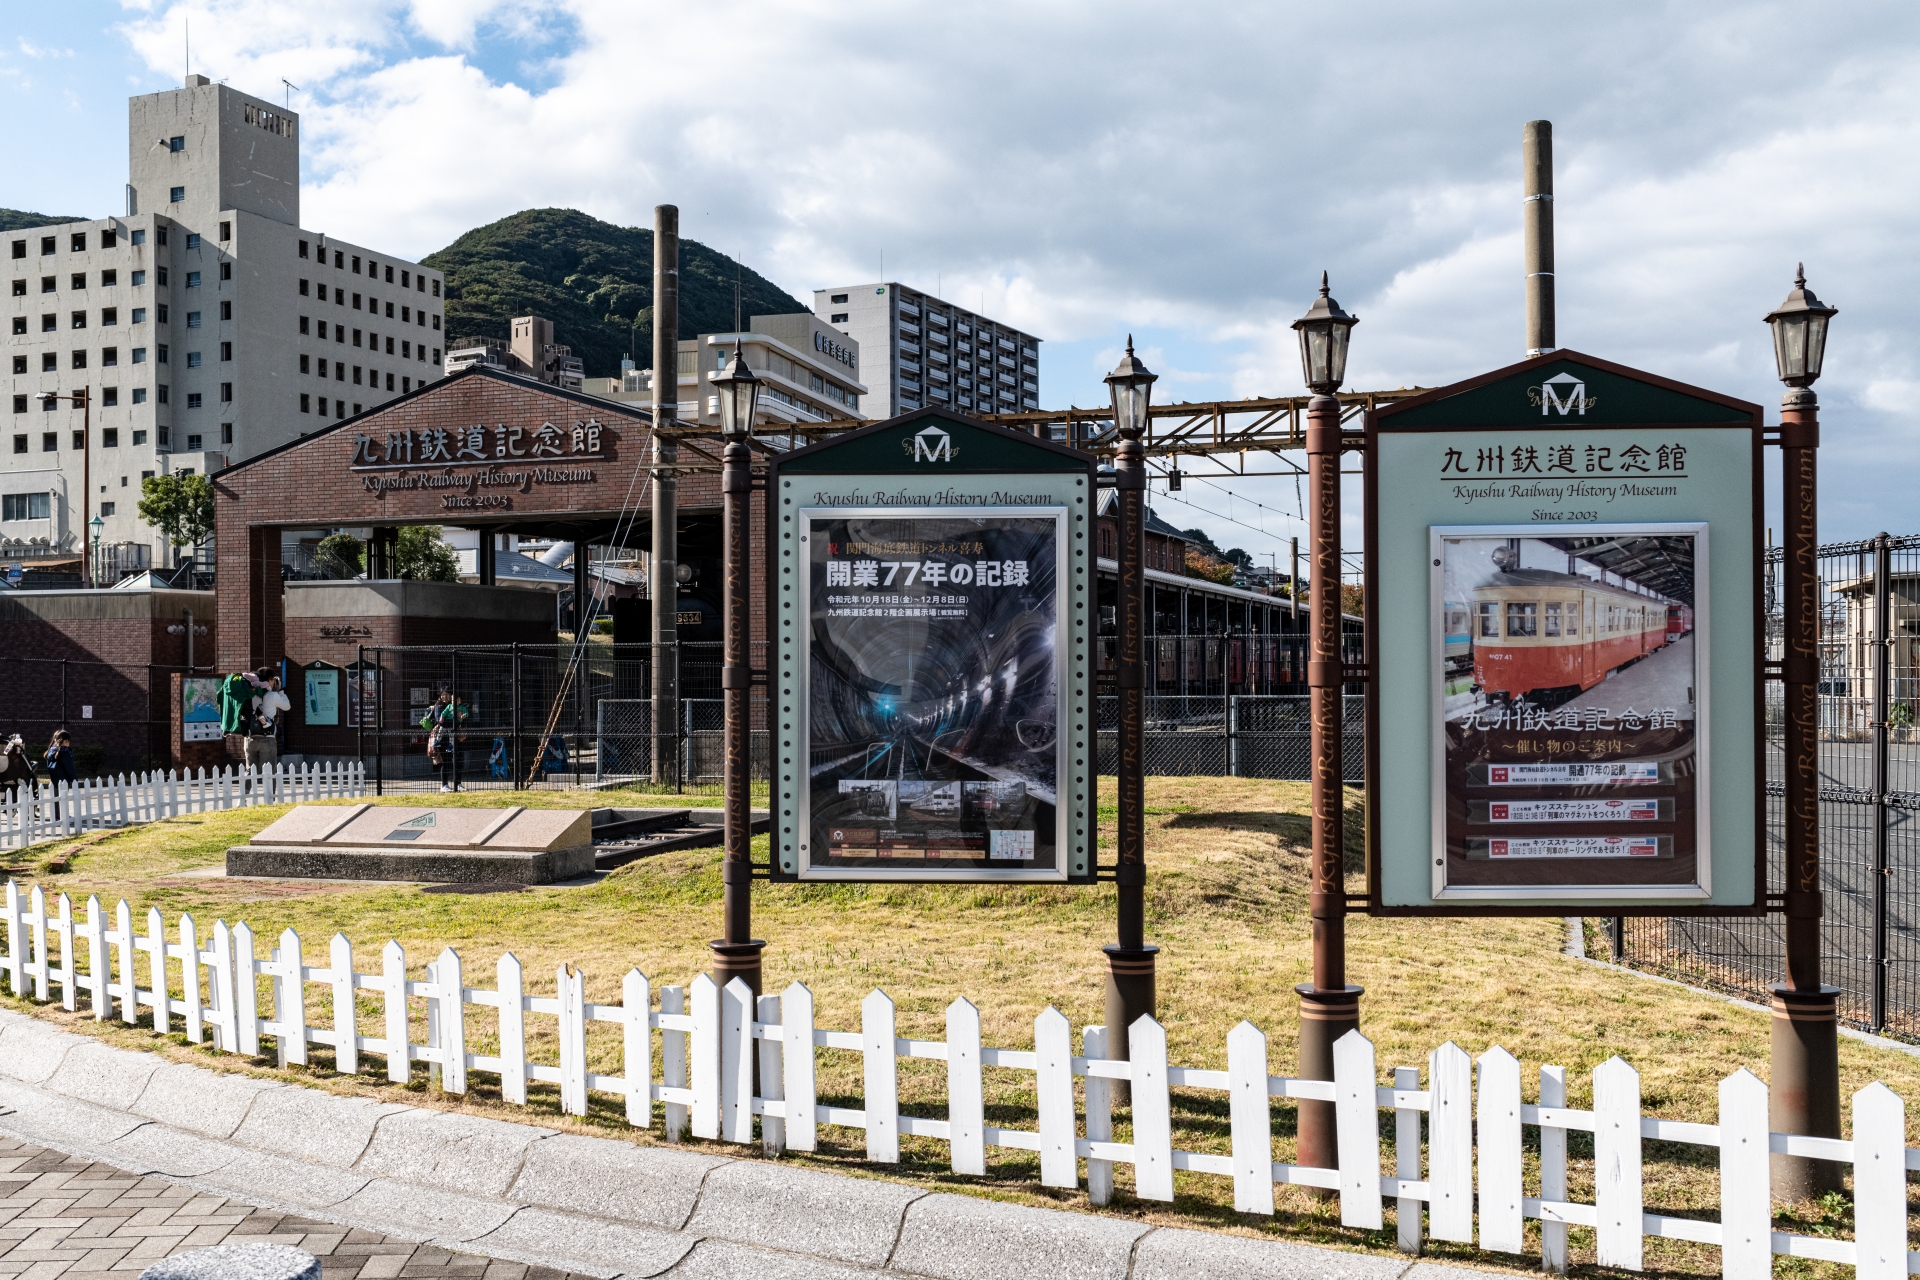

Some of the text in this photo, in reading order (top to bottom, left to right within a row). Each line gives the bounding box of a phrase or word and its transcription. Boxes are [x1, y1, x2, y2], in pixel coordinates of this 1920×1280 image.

[351, 418, 603, 463] 九州鉄道記念館
[1441, 443, 1687, 474] 九州鉄道記念館
[361, 465, 592, 497] Kyushu Railway History Museum
[440, 494, 508, 508] Since 2003
[813, 487, 1052, 507] Kyushu Railway History Museum
[1316, 454, 1334, 568] Museum
[1452, 480, 1678, 504] Kyushu Railway History Museum
[1795, 449, 1814, 565] Museum
[1123, 490, 1137, 588] Museum
[1531, 508, 1598, 522] Since 2003
[826, 541, 984, 555] 祝 関門海底鉄道トンネル喜寿
[826, 560, 1030, 587] 開業77年の記録
[726, 689, 741, 765] Railwa
[1121, 689, 1137, 768] Railwa
[1313, 686, 1334, 780] Railwa
[1460, 706, 1678, 732] 九州鉄道記念館
[1794, 684, 1815, 778] Railwa
[725, 773, 745, 861] Kyushu
[1121, 775, 1142, 865] Kyushu
[1315, 788, 1340, 893] Kyushu
[1532, 838, 1597, 846] キッズステーション
[1794, 786, 1817, 893] Kyushu
